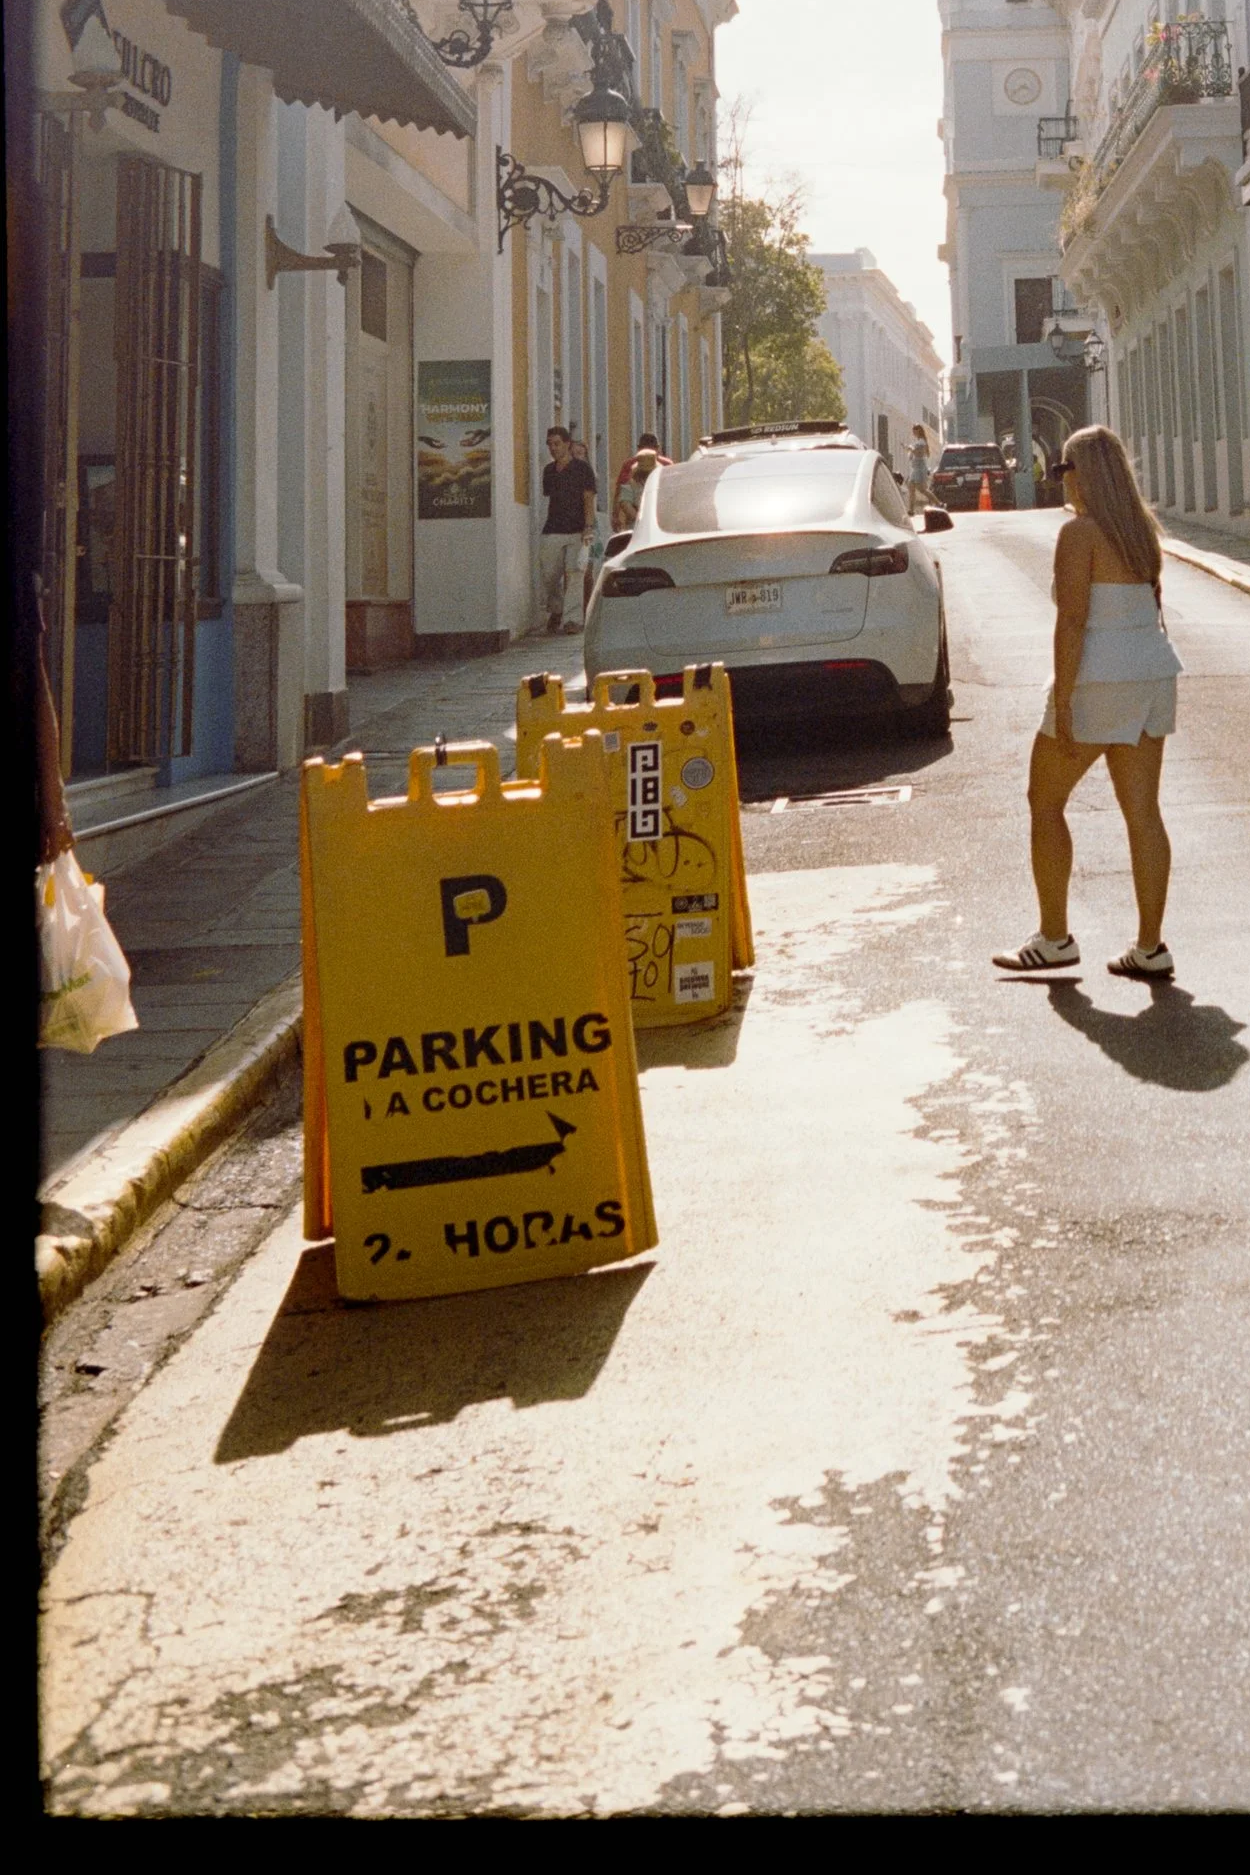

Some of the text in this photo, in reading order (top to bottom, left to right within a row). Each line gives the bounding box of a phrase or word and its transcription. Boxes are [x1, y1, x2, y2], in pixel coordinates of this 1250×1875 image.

[440, 875, 507, 957] P
[343, 1013, 612, 1082] PARKING
[422, 1068, 600, 1112] COCHERA
[444, 1200, 625, 1257] HORAS
